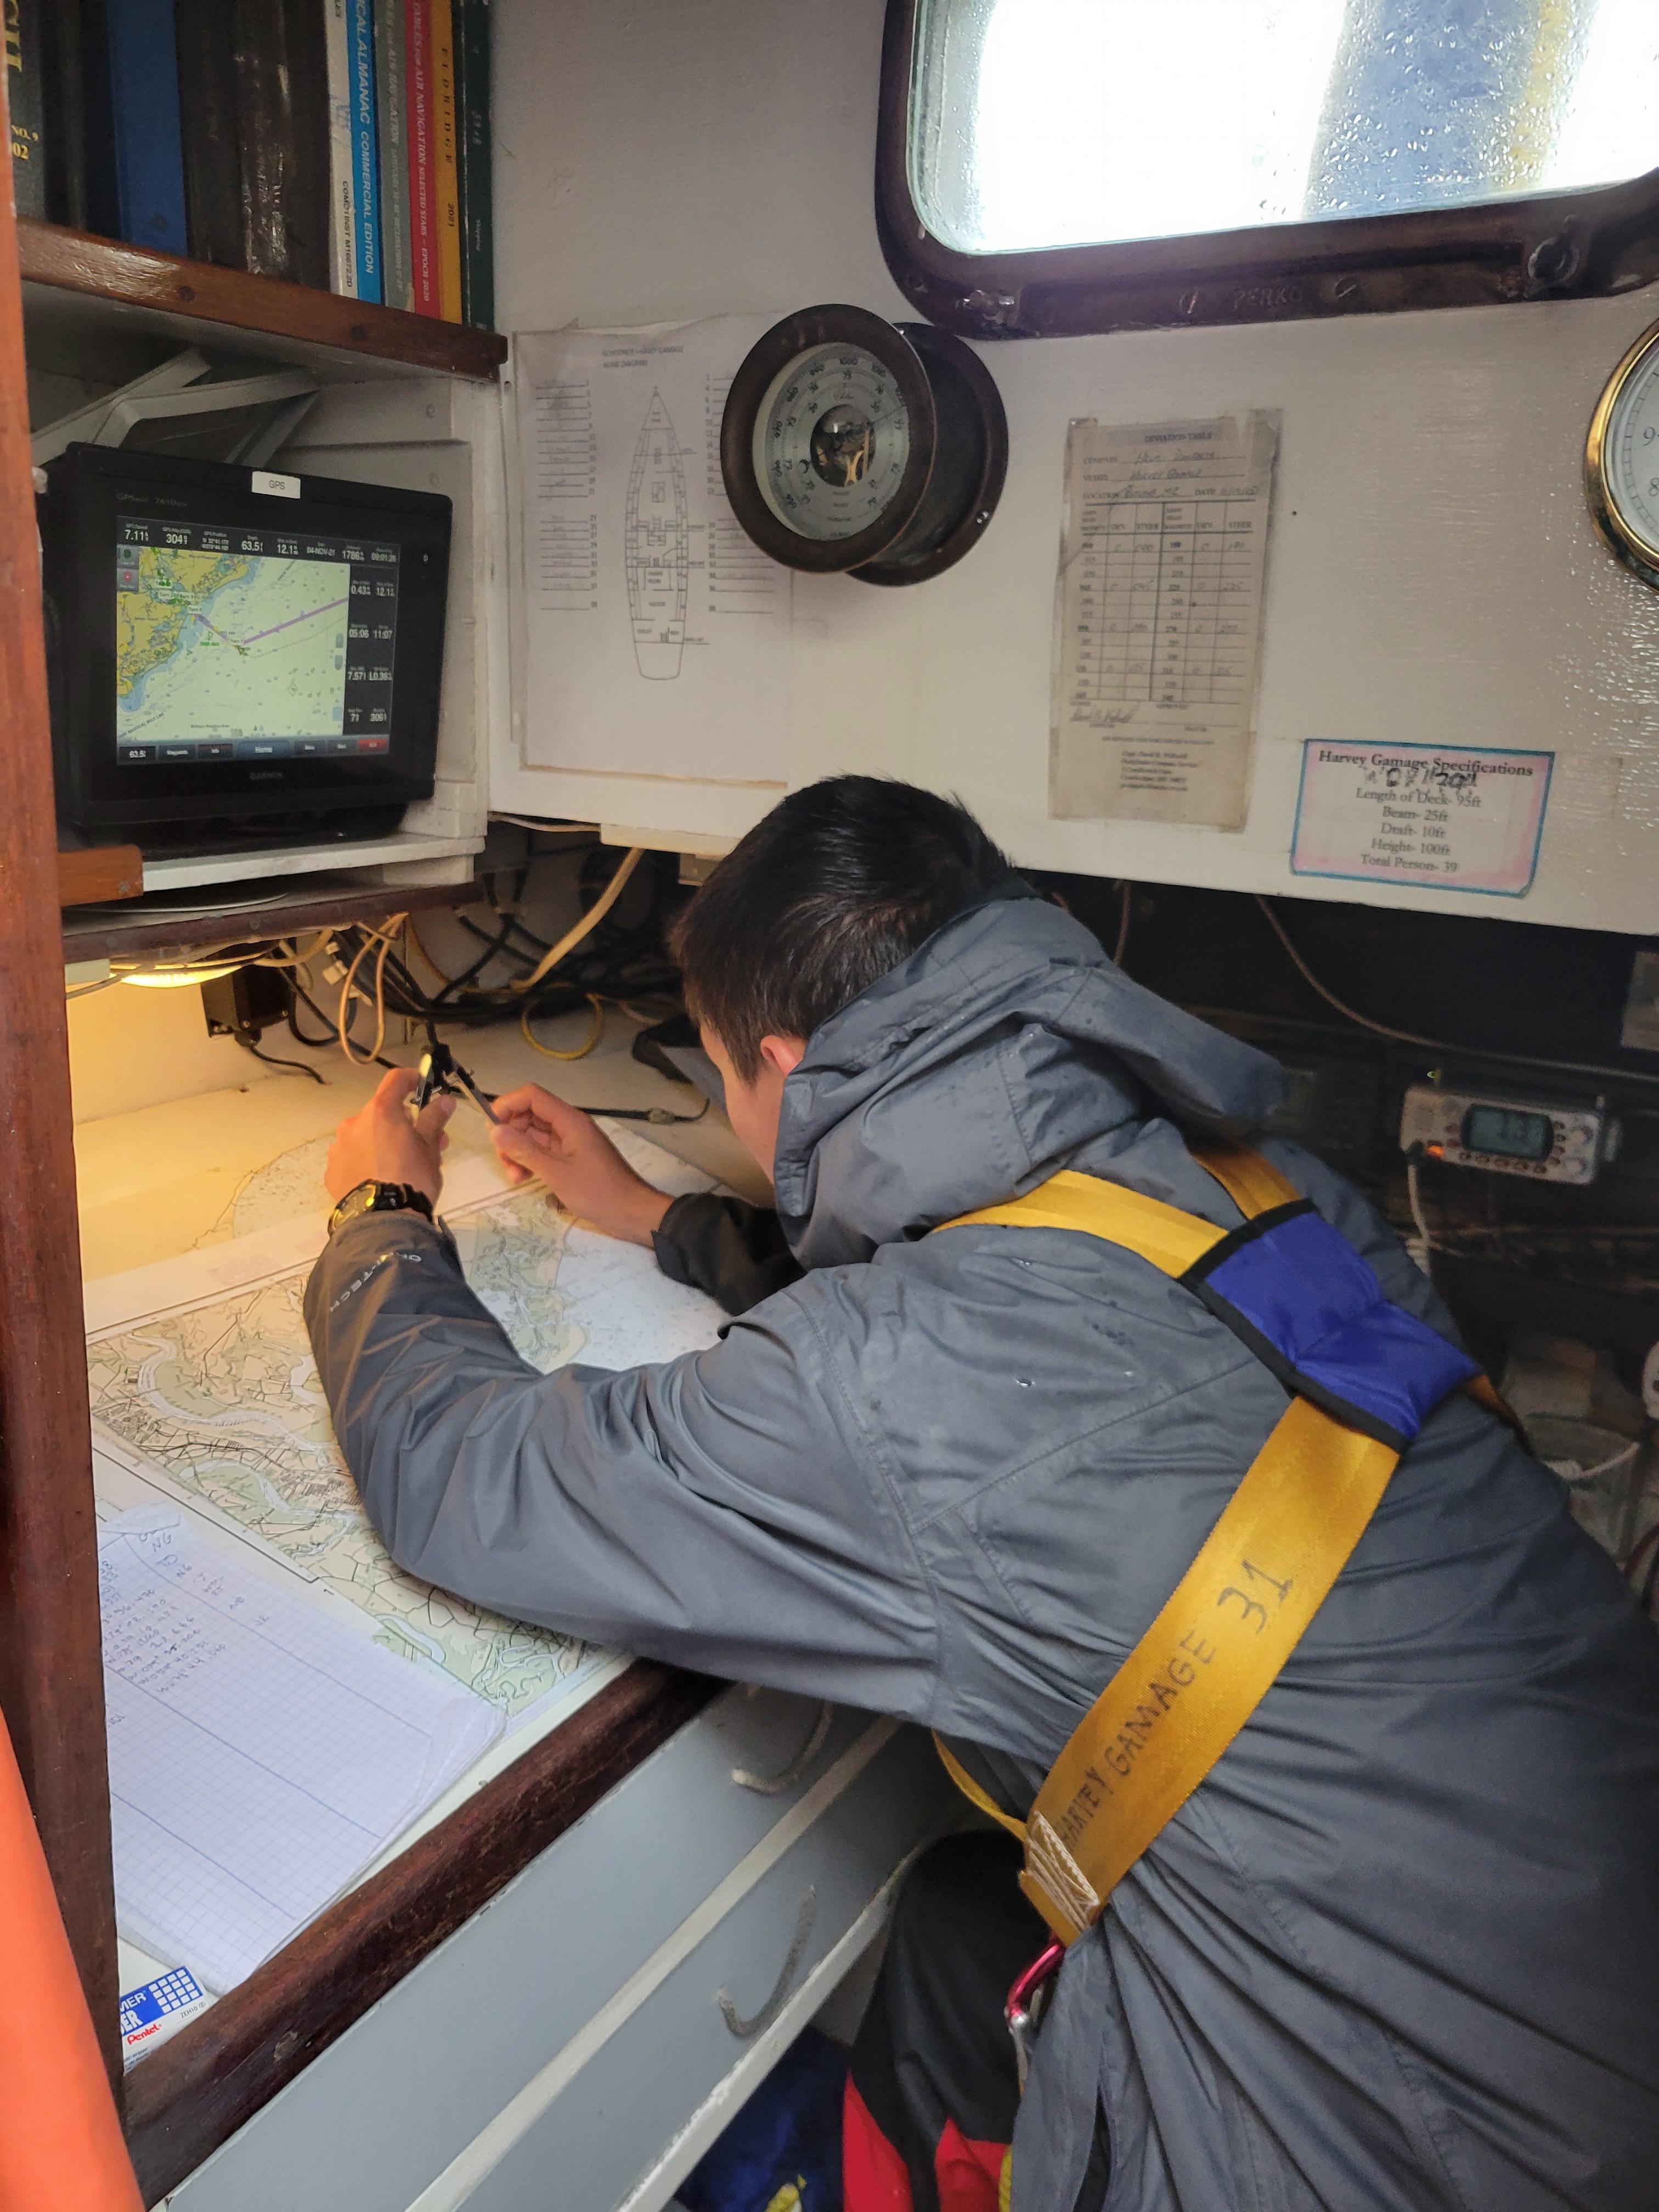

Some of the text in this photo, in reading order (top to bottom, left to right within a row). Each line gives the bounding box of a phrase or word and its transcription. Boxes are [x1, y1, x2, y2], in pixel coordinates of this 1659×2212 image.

[358, 38, 370, 124] ALMANAC
[415, 67, 424, 91] AIR
[416, 93, 426, 165] NAVIGATION
[10, 142, 29, 160] 02
[360, 131, 373, 219] COMMERCIAL
[364, 223, 374, 274] EDITION
[269, 479, 286, 490] GPS
[124, 529, 144, 540] 7.11
[166, 533, 183, 544] 304
[1318, 750, 1533, 776] Harvey Gamage Specifications
[1356, 787, 1396, 803] Length
[1400, 792, 1413, 803] of
[1456, 795, 1481, 808] 95ft
[1423, 808, 1449, 822] 25ft
[1423, 826, 1446, 839] 10ft
[1420, 843, 1450, 856] 100ft
[1361, 853, 1390, 867] Total
[1443, 861, 1458, 872] 39
[1103, 1628, 1216, 1779] GAMAGE
[1216, 1558, 1293, 1635] 31
[126, 2023, 160, 2045] Pentel
